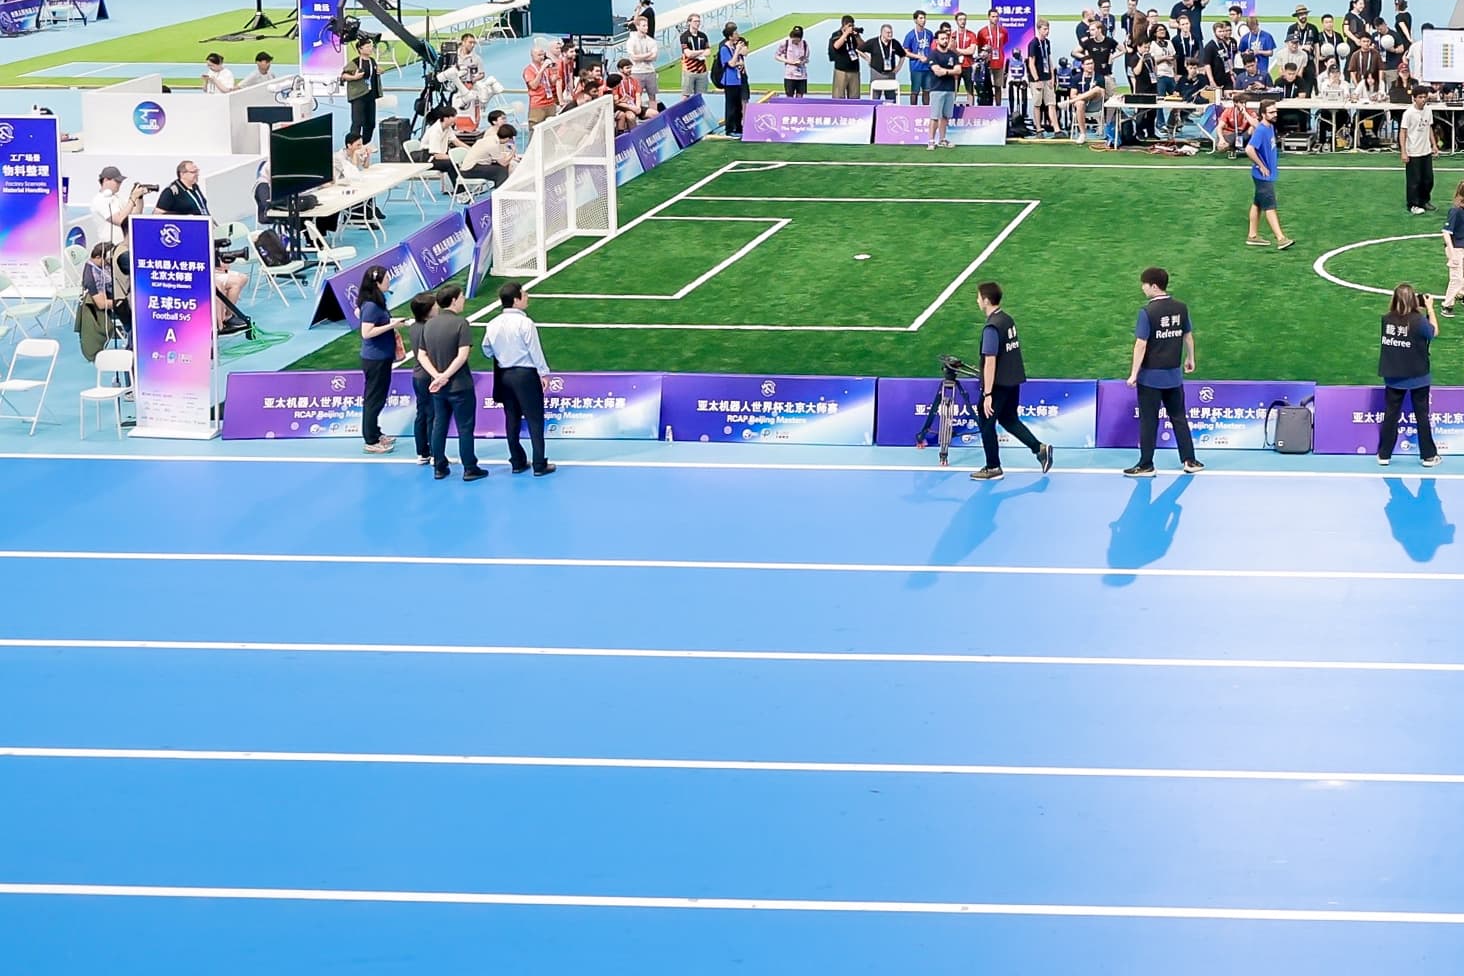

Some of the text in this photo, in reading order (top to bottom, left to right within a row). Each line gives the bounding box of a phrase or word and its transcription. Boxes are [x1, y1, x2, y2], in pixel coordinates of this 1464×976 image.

[2, 165, 50, 178] 物料整理
[137, 259, 206, 272] 亚太机器人世界杯
[150, 270, 193, 282] 北京大师赛
[148, 296, 197, 311] 足球5v5
[152, 310, 179, 322] Football
[1160, 315, 1181, 328] 裁判
[164, 328, 177, 343] A
[1155, 328, 1183, 340] Referee
[1386, 324, 1408, 337] 裁判
[1381, 336, 1411, 348] Referee
[696, 400, 840, 414] 亚太机器人世界杯北京大师赛
[294, 410, 317, 419] RCAP
[317, 410, 341, 420] Beijing
[727, 415, 750, 423] RCAP
[749, 415, 775, 425] Beijing
